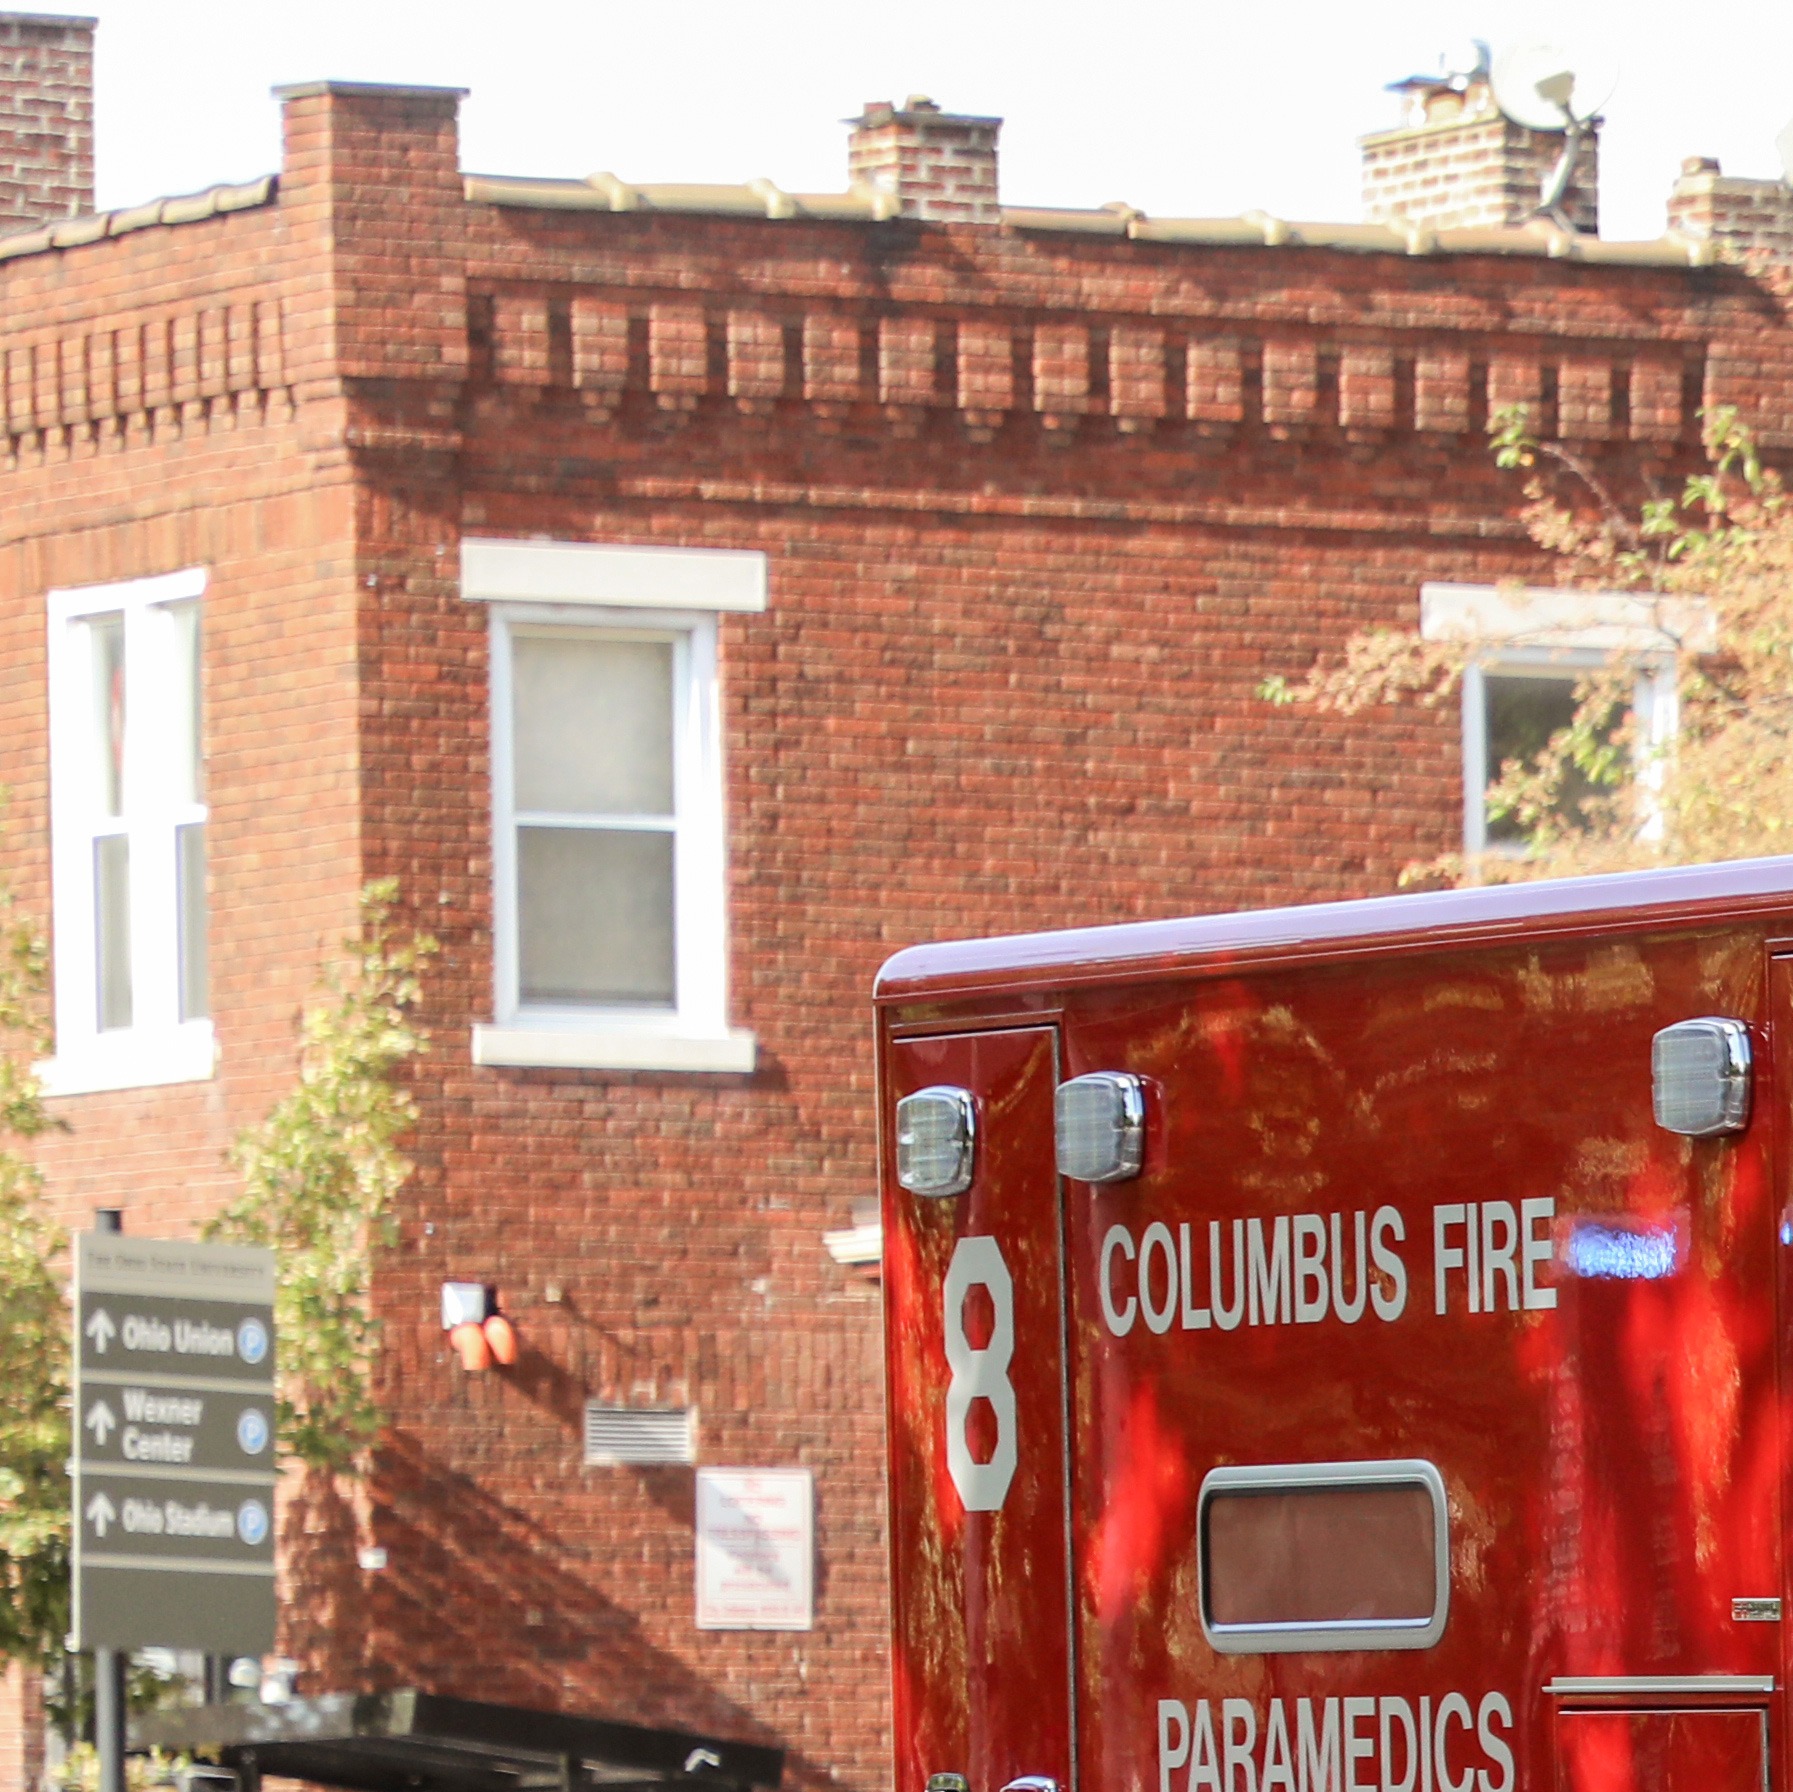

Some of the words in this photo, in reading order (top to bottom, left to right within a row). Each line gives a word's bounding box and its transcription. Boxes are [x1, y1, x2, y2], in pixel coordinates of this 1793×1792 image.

[1101, 1205, 1405, 1337] COLUMBUS
[1433, 1196, 1557, 1315] FIRE
[122, 1315, 171, 1352] Ohio
[173, 1318, 234, 1357] Union
[942, 1236, 1018, 1511] 8
[122, 1389, 202, 1426] Wexner
[122, 1427, 193, 1463] Center
